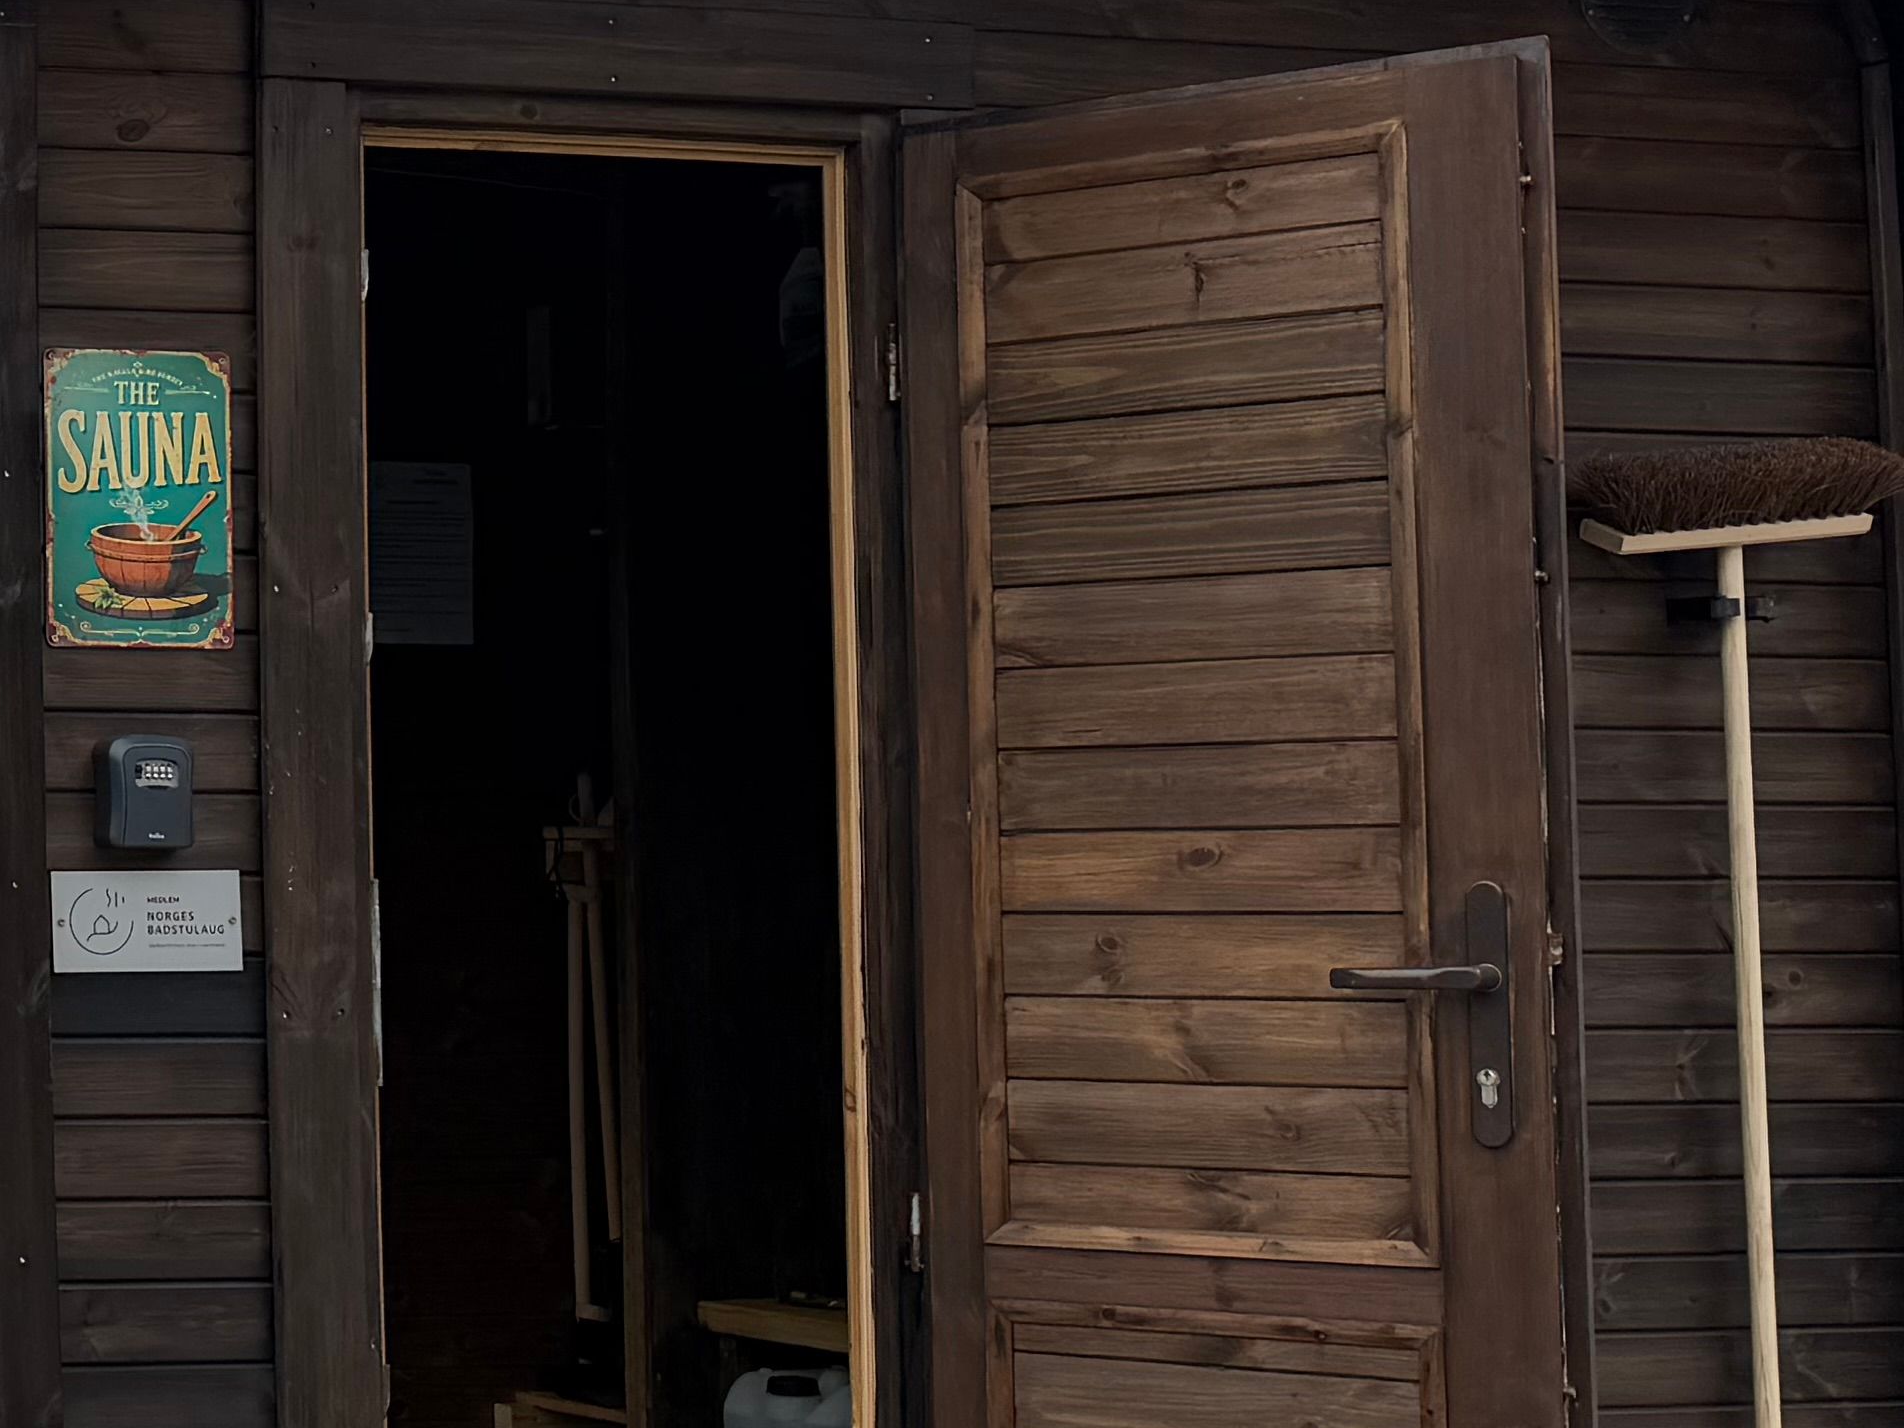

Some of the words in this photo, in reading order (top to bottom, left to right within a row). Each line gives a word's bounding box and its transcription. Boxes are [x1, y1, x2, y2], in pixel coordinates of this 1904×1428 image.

[113, 380, 160, 406] THE
[57, 409, 222, 494] SAUNA
[147, 912, 194, 921] NORGES
[147, 925, 225, 935] BADSTULAUG
